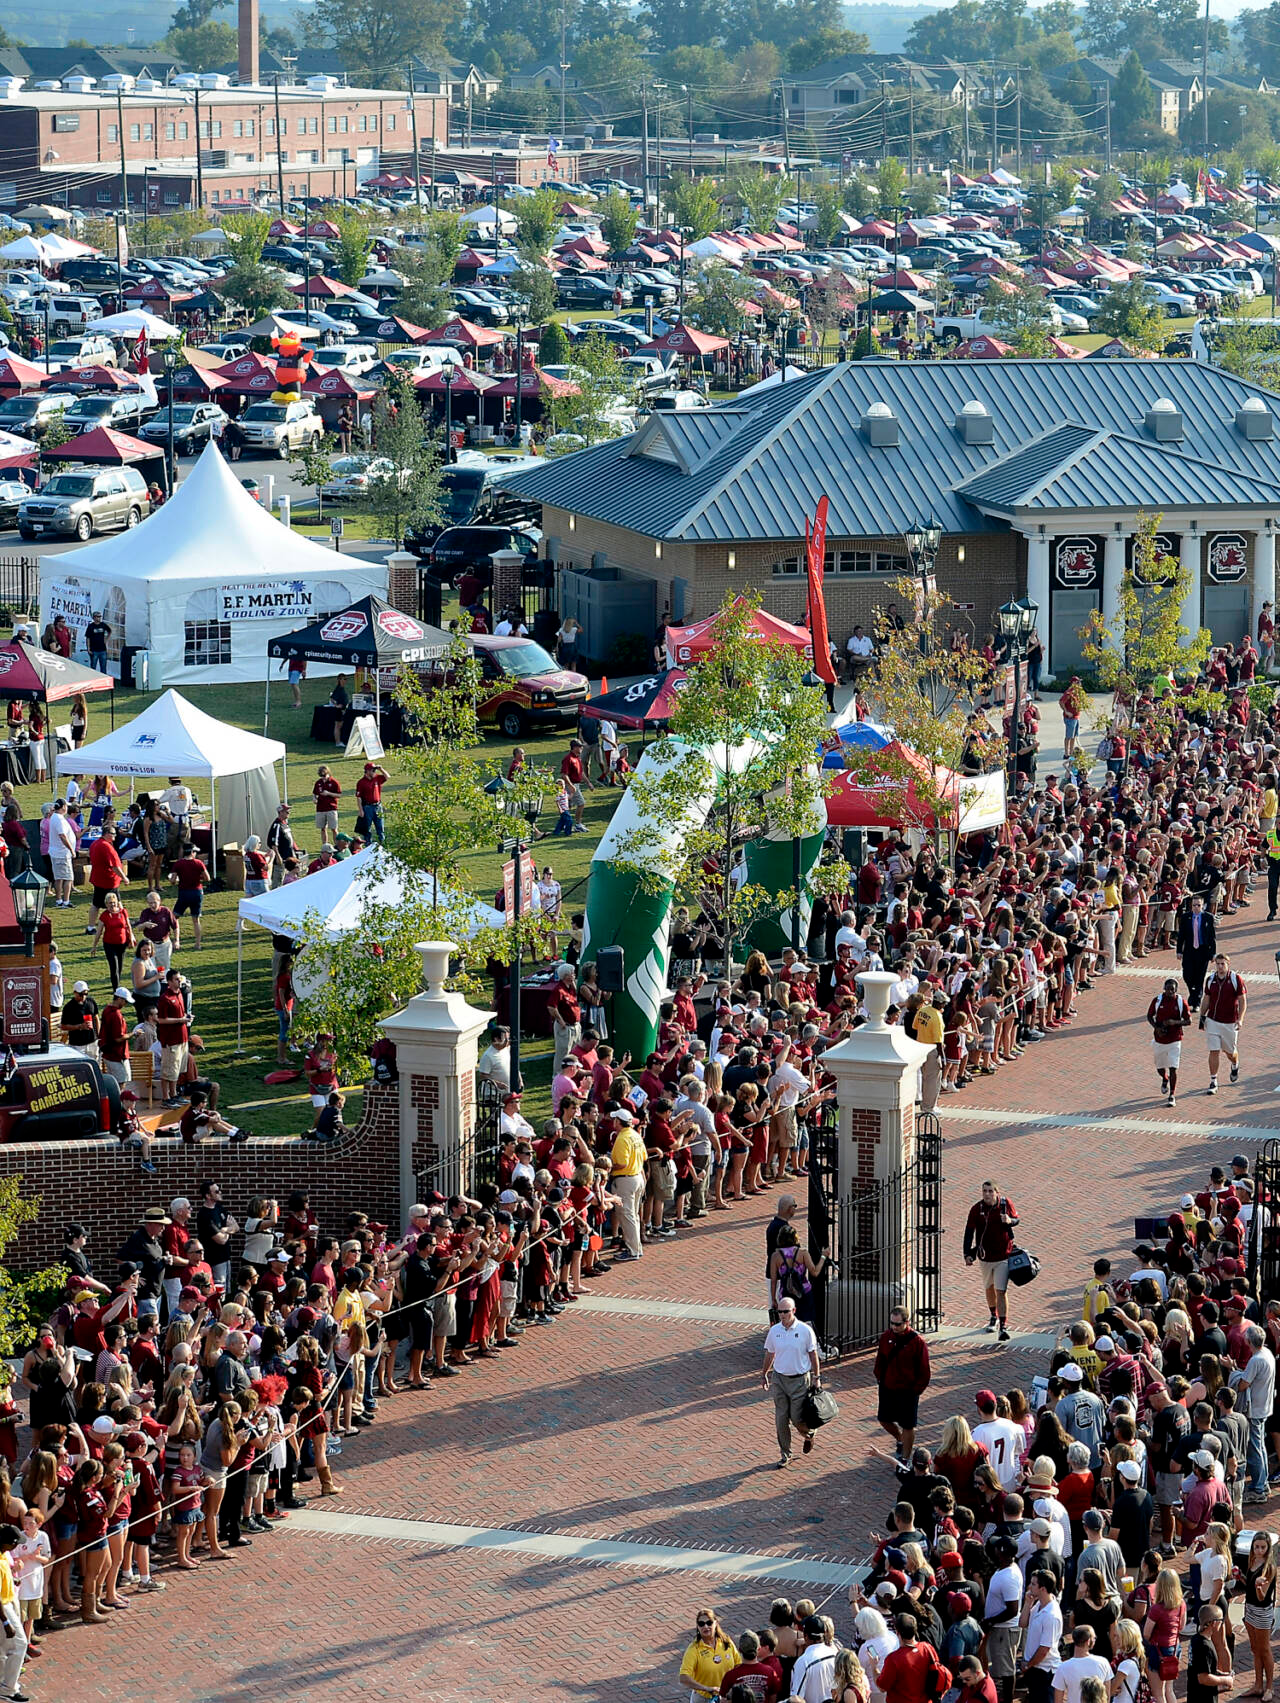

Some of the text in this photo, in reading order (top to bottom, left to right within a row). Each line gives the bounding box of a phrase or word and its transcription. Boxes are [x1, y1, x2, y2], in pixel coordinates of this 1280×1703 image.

[248, 592, 312, 608] MARTIN
[224, 607, 310, 619] COOLING ZONE
[327, 621, 362, 633] CPI
[384, 621, 418, 633] CPI
[304, 650, 343, 661] cpisecurity.com
[28, 1065, 63, 1088] HOME
[46, 1075, 78, 1095] OF THE
[30, 1082, 92, 1113] GAMECOCKS
[994, 1438, 1004, 1464] 7
